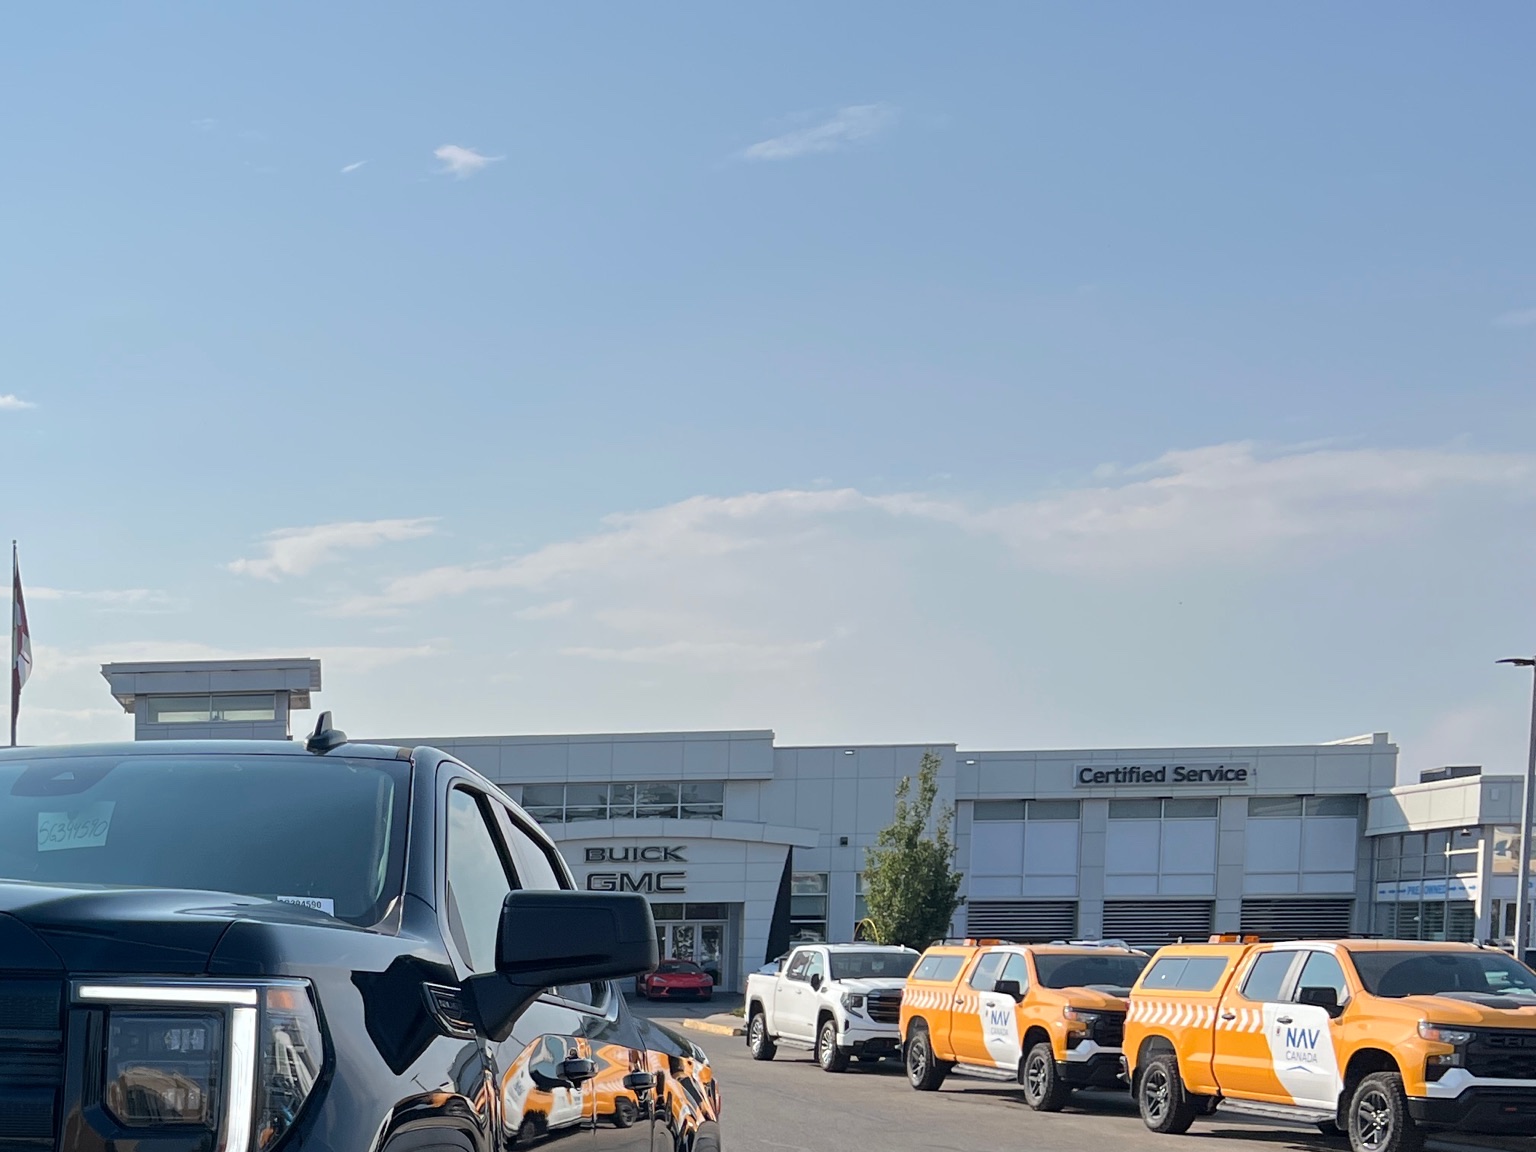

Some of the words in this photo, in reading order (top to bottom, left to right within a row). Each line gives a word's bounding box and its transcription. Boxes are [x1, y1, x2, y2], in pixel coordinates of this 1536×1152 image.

[1079, 766, 1166, 784] Certified
[1172, 765, 1247, 783] Service
[584, 846, 688, 864] BUICK
[585, 870, 687, 894] GMC
[990, 1010, 1010, 1026] NAV
[1286, 1027, 1320, 1049] NAV
[1286, 1050, 1317, 1063] CANADA
